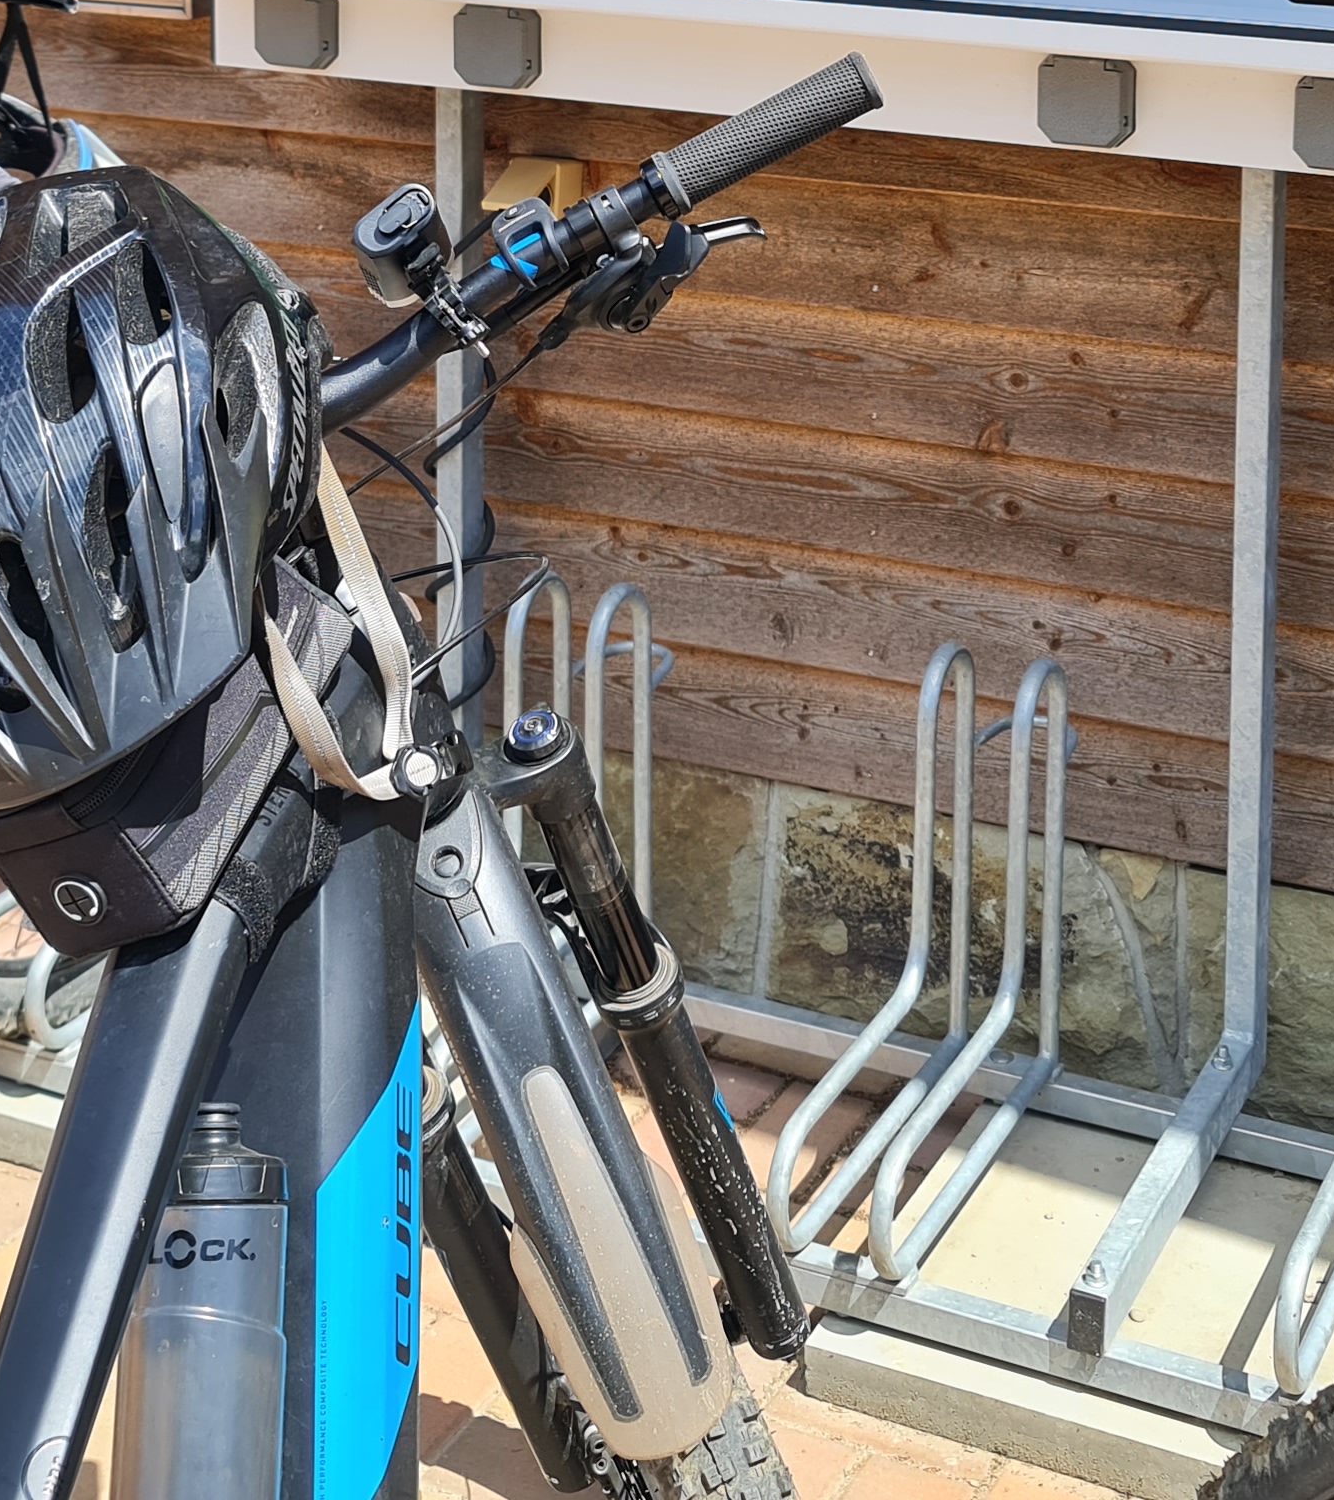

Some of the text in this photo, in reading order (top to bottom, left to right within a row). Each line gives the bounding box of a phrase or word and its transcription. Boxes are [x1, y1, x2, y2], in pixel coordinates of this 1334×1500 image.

[395, 1080, 413, 1367] CUBE
[320, 1300, 328, 1360] TECHNOLOGY
[319, 1363, 327, 1417] COMPOSITE
[319, 1419, 327, 1490] PERFORMANCE
